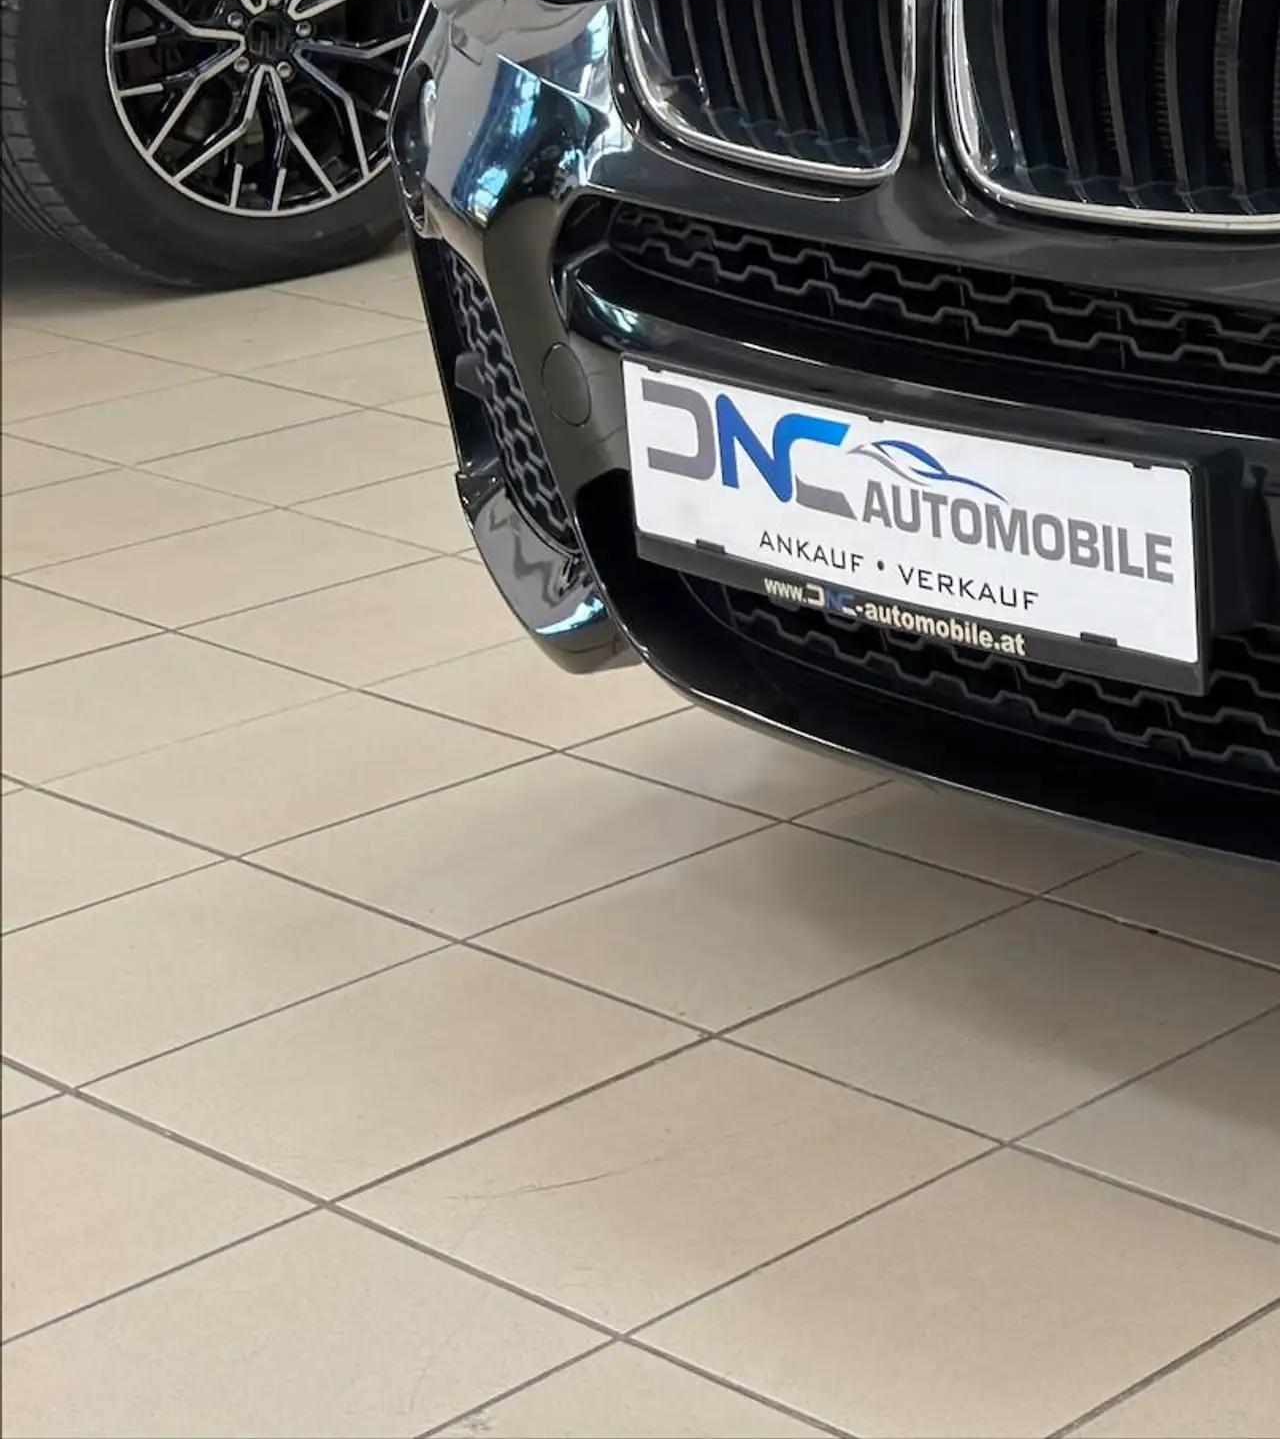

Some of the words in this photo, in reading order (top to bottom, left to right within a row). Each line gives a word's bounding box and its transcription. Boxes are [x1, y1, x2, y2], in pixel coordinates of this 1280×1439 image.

[758, 530, 865, 574] ANKAUF
[897, 563, 1040, 611] VERKAUF
[861, 479, 1175, 584] AUTOMOBILE
